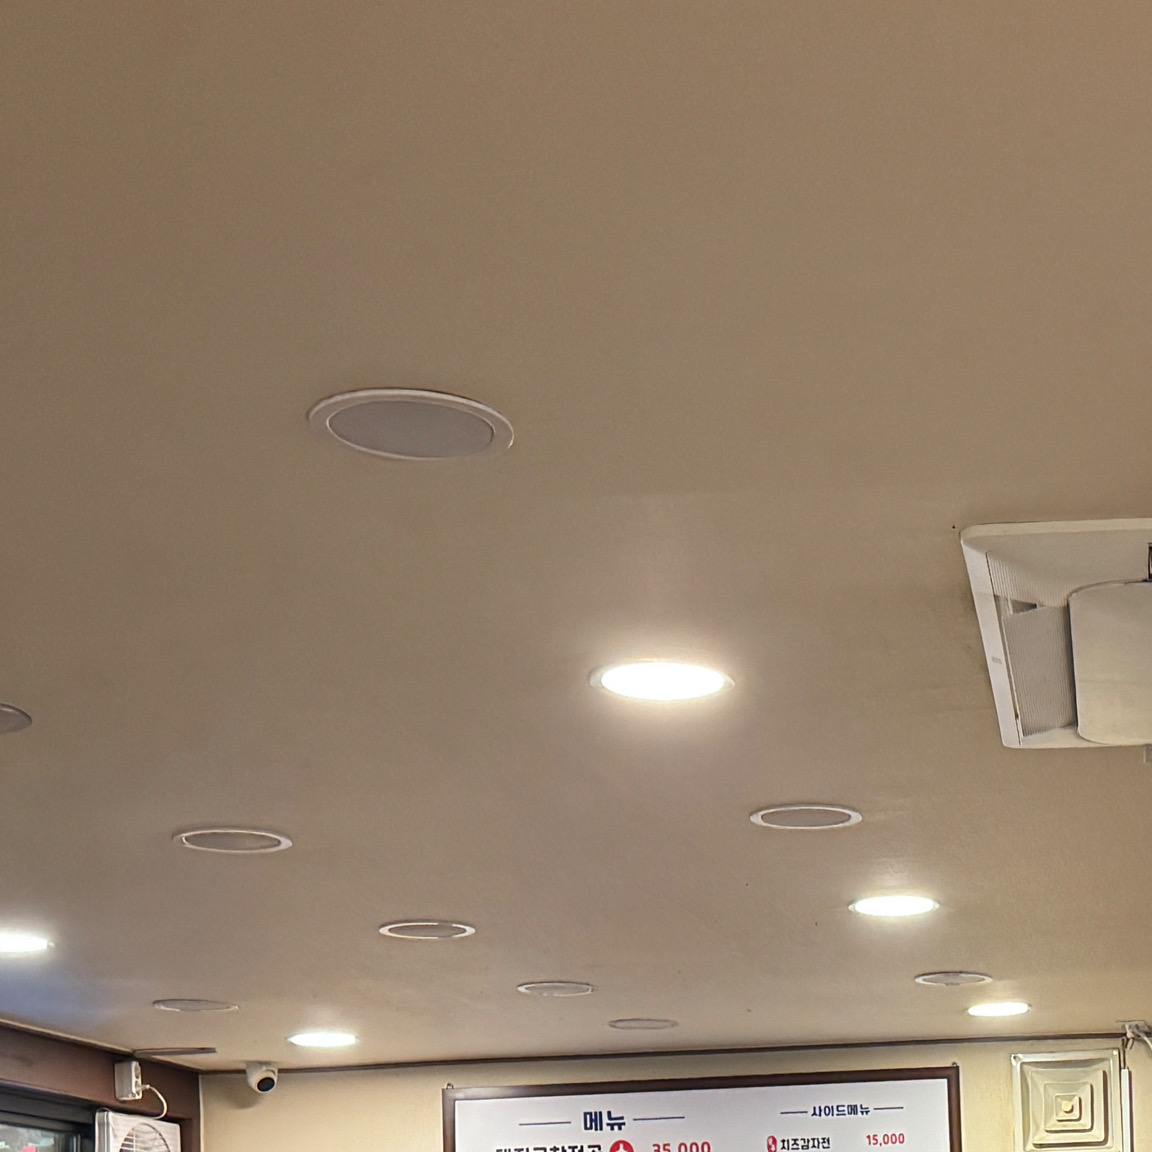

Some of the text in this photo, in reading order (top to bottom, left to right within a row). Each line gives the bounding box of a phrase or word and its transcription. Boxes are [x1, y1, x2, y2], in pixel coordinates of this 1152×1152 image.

[811, 1104, 870, 1117] 사이드메뉴
[583, 1111, 626, 1132] 메뉴
[780, 1133, 905, 1151] 치즈감자전 15,000
